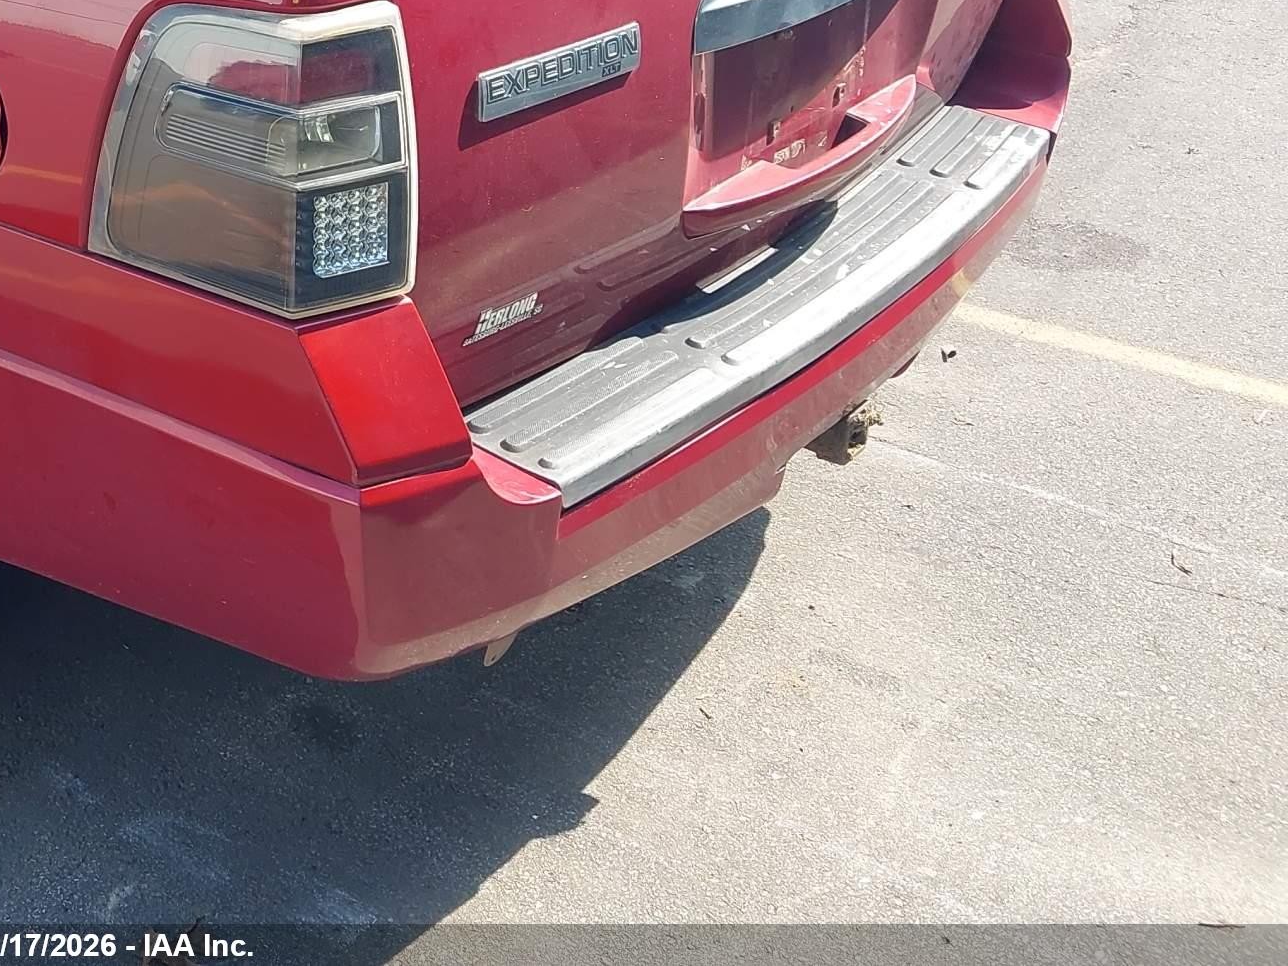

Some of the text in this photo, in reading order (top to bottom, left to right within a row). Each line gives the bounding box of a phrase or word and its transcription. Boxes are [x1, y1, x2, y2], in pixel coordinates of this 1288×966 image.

[485, 29, 640, 105] EXPEDITION
[602, 62, 621, 77] XLT
[474, 292, 538, 335] HERLONG
